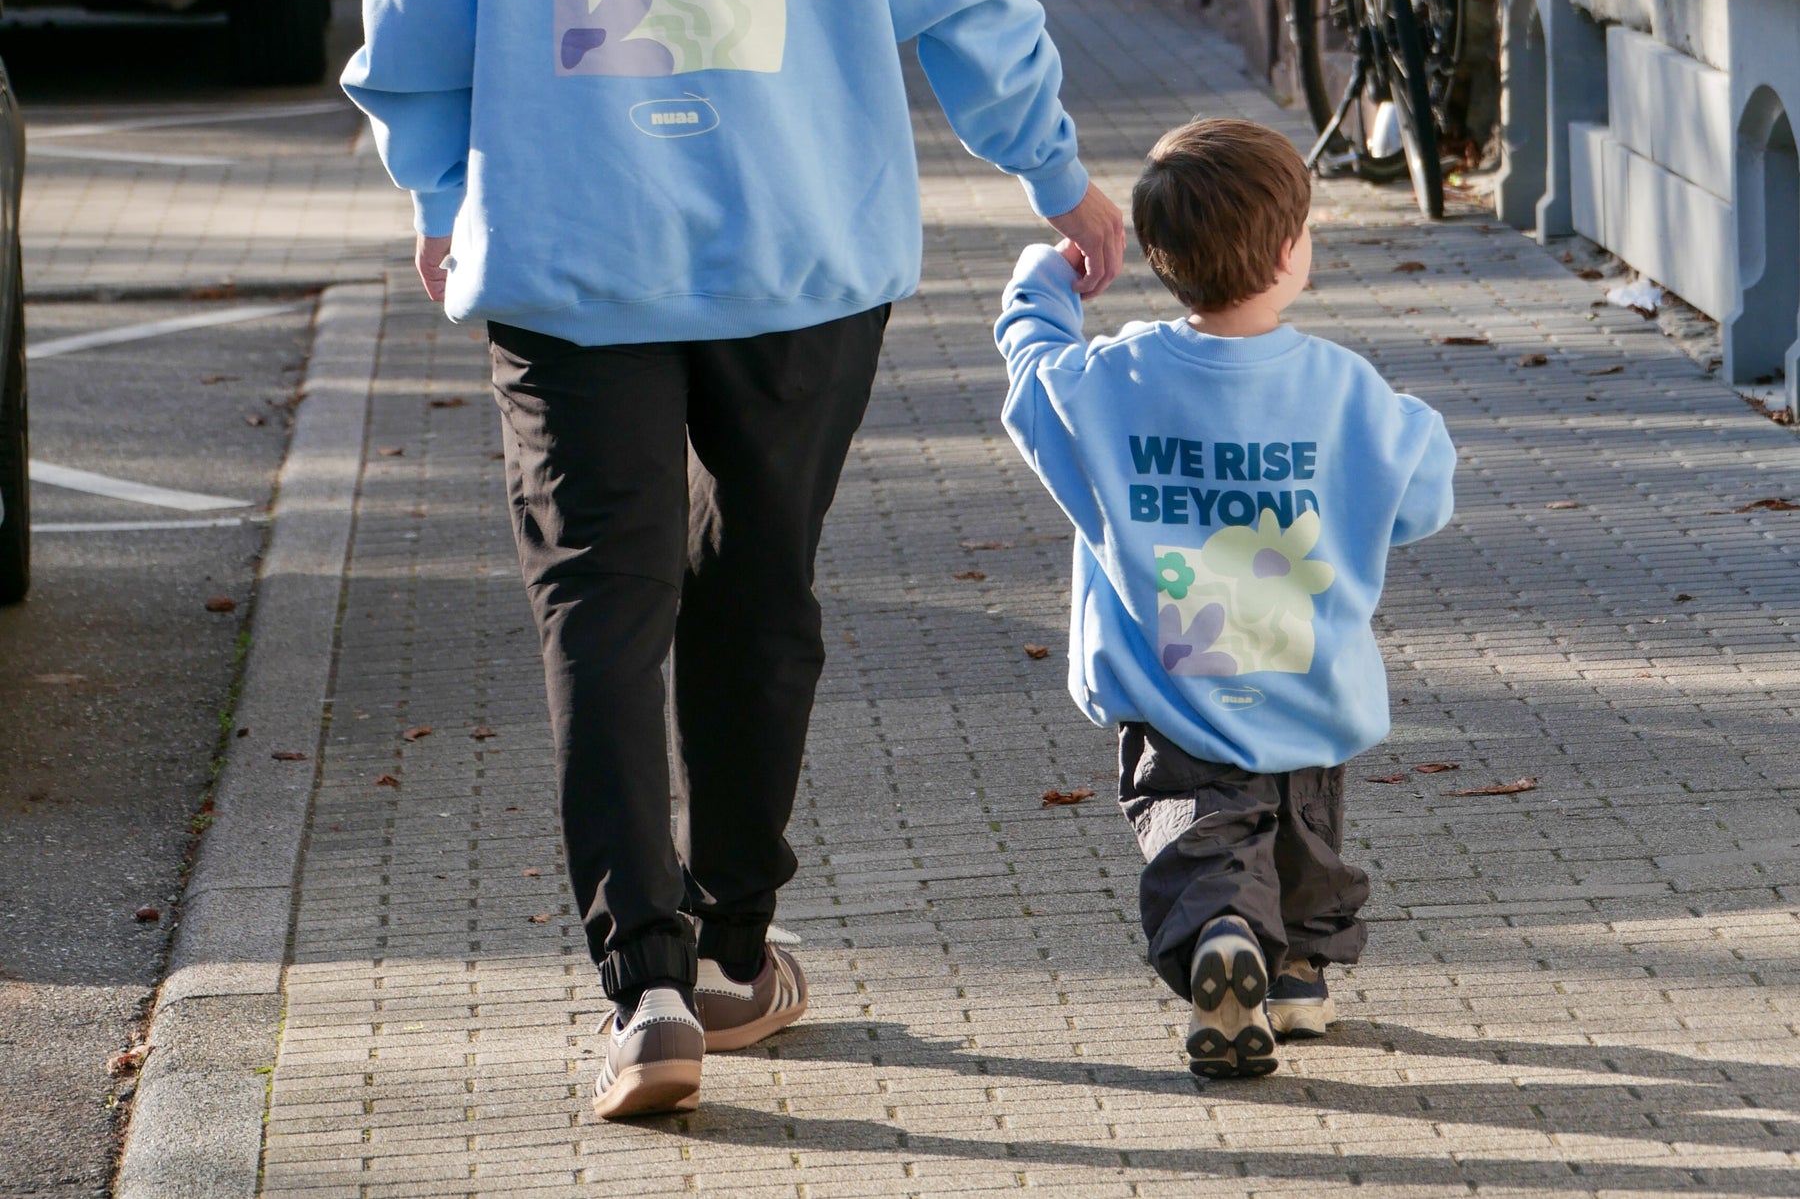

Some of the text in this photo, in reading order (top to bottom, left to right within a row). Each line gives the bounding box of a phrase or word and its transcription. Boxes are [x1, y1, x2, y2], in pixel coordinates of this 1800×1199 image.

[651, 112, 699, 125] nuaa
[1128, 435, 1318, 481] WE RISE
